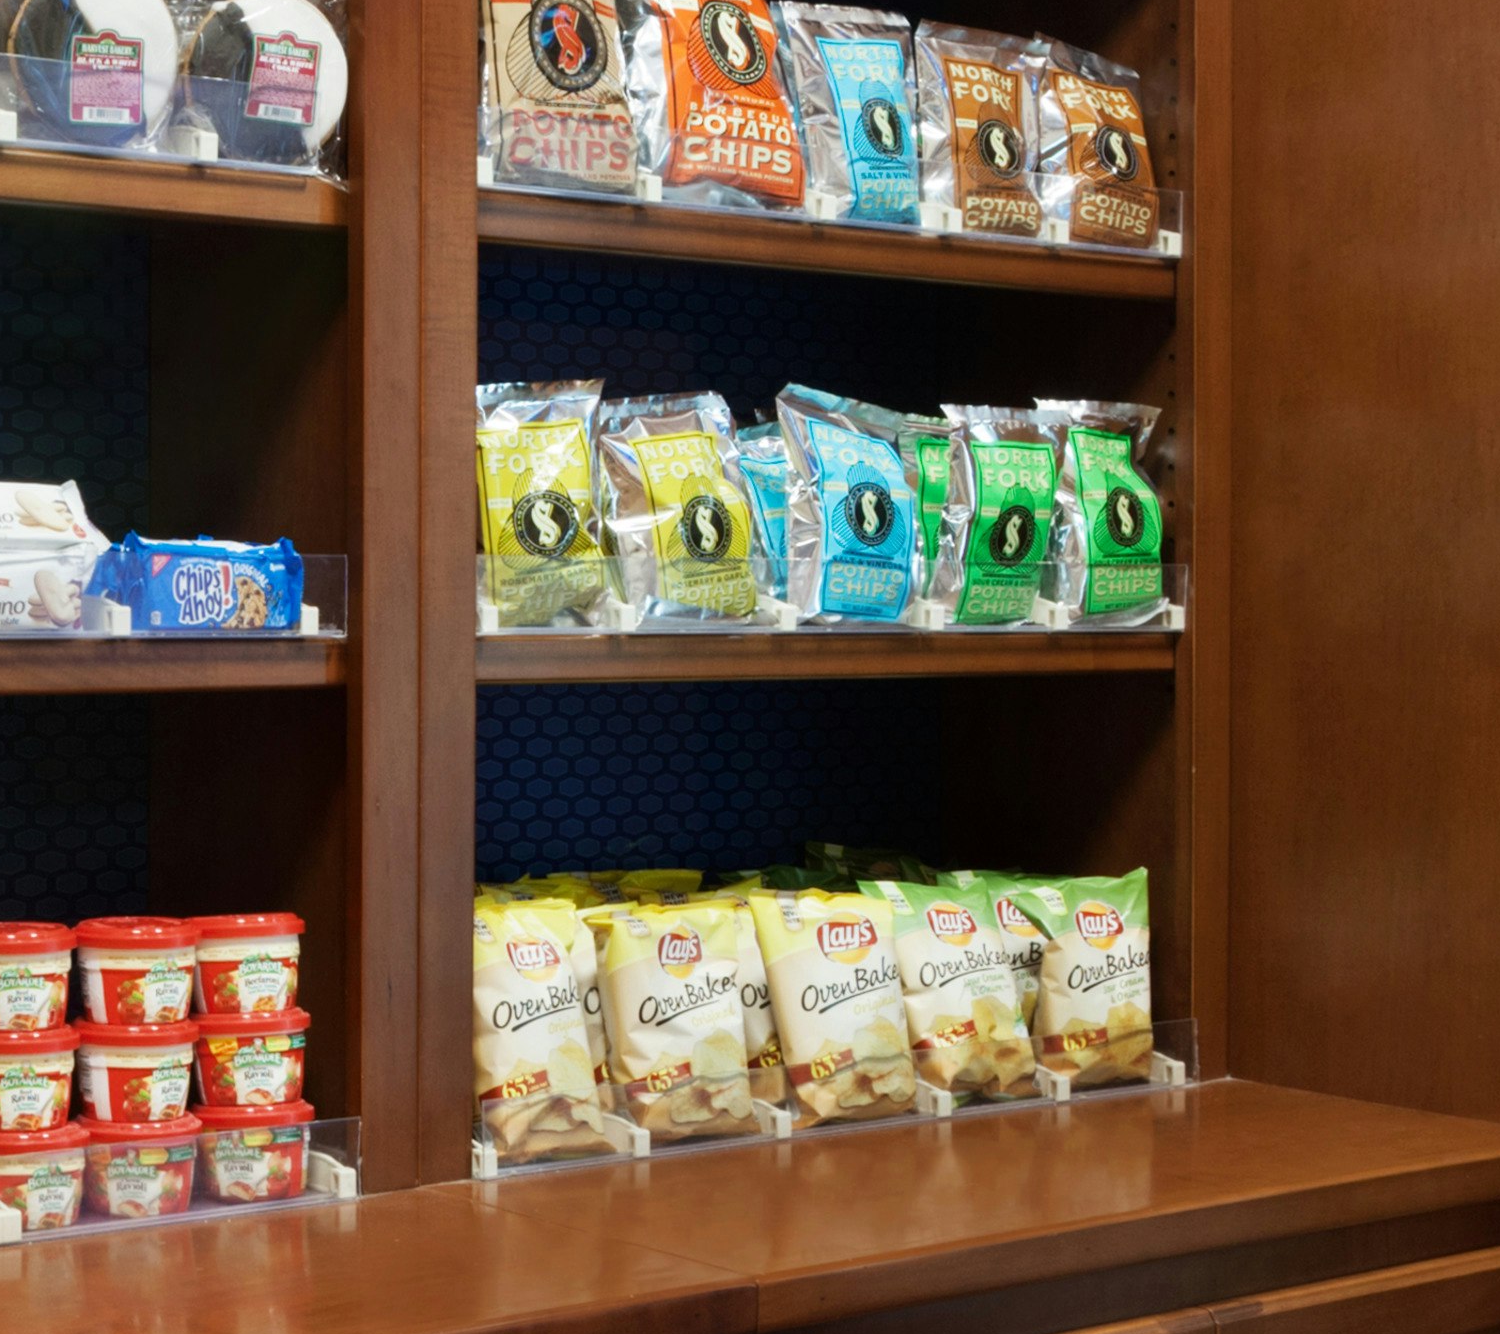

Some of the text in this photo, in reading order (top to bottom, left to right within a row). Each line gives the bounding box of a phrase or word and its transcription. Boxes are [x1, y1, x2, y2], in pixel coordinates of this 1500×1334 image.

[687, 113, 792, 146] POTATO
[683, 137, 792, 175] CHIPS
[978, 448, 1047, 465] NORTH
[983, 468, 1049, 489] FORK
[1093, 577, 1157, 595] CHIPS
[929, 909, 974, 934] Lay's
[661, 932, 699, 965] Lay's
[821, 921, 874, 950] Lay's
[6, 993, 37, 1005] Ravioli
[800, 977, 856, 1013] Oven
